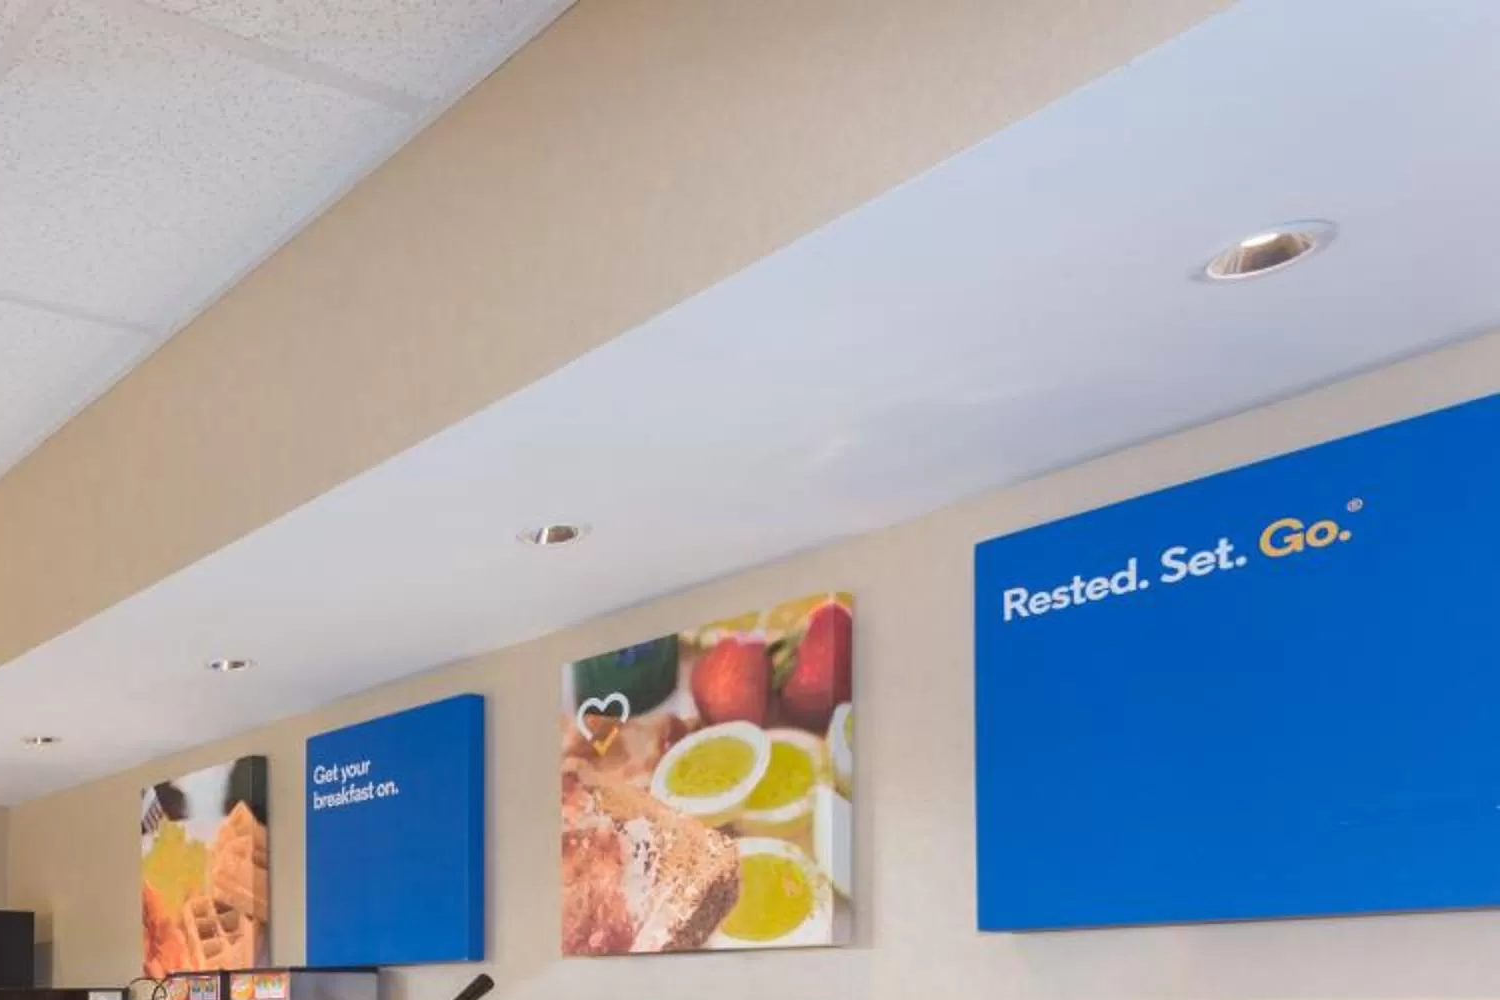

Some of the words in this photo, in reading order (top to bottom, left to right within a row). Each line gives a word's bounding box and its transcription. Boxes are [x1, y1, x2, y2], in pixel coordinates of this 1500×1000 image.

[1002, 558, 1149, 622] Rested.
[1159, 537, 1248, 585] Set.
[313, 763, 338, 785] Get
[341, 760, 371, 782] your
[313, 781, 375, 811] breakfast
[375, 780, 399, 798] on.
